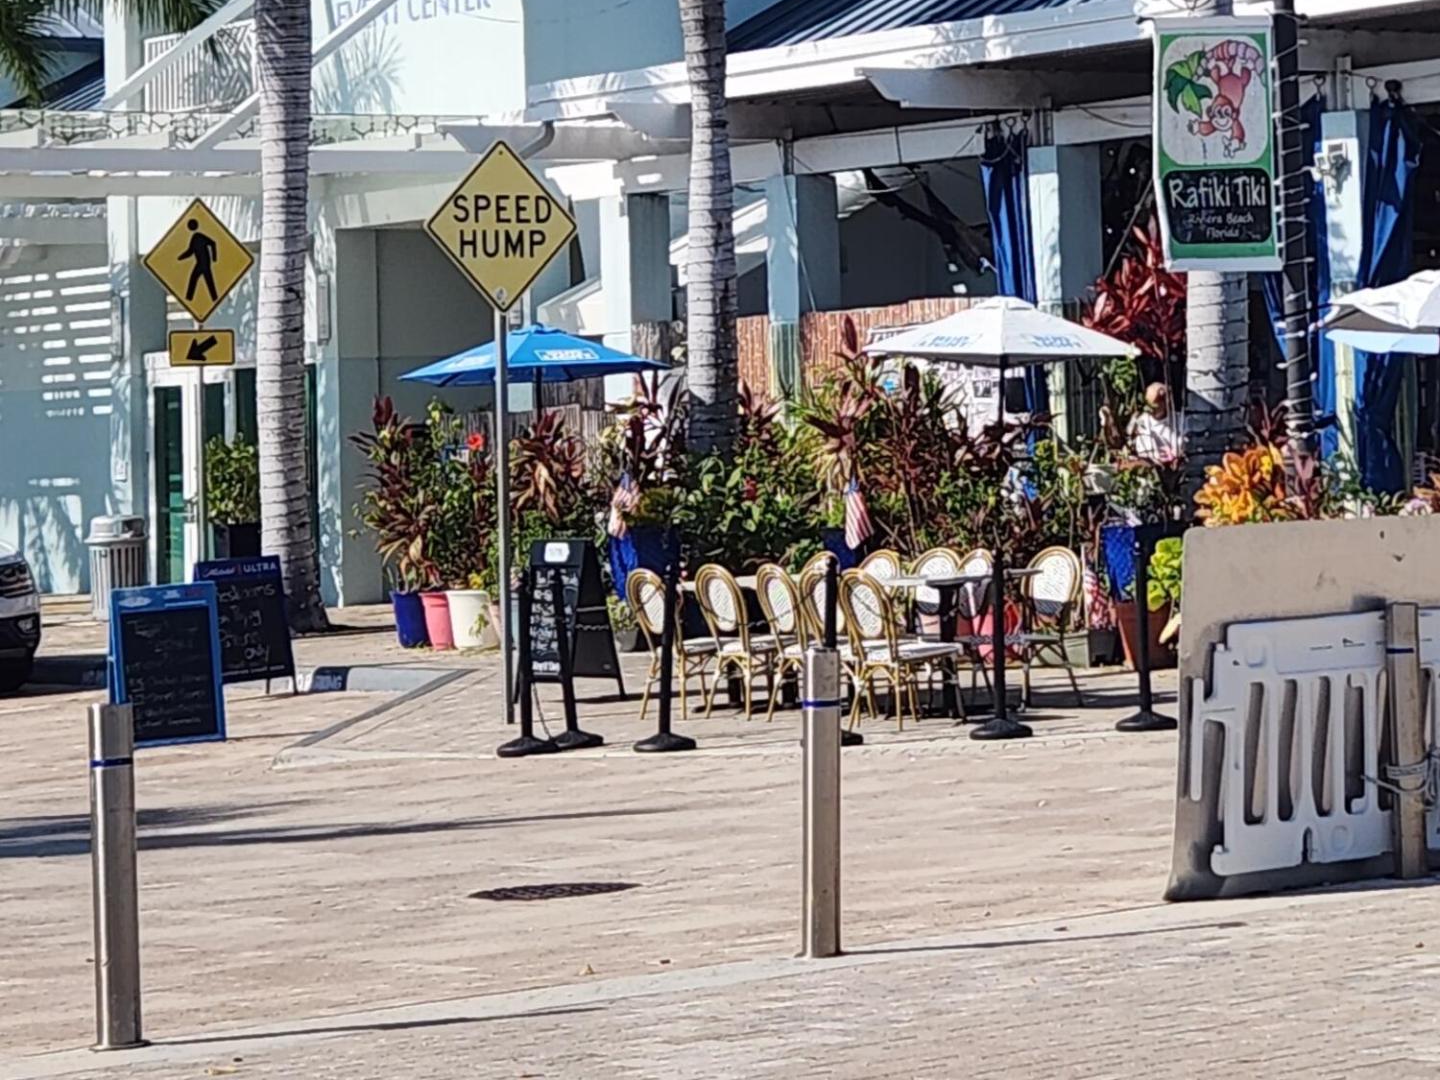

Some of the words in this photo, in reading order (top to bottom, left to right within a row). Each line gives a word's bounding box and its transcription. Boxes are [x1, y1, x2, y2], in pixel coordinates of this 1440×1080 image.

[1169, 176, 1231, 208] Rafiki
[1232, 176, 1266, 206] Tiki
[453, 194, 551, 224] SPEED
[459, 230, 547, 258] HUMP
[243, 561, 278, 574] ULTRA
